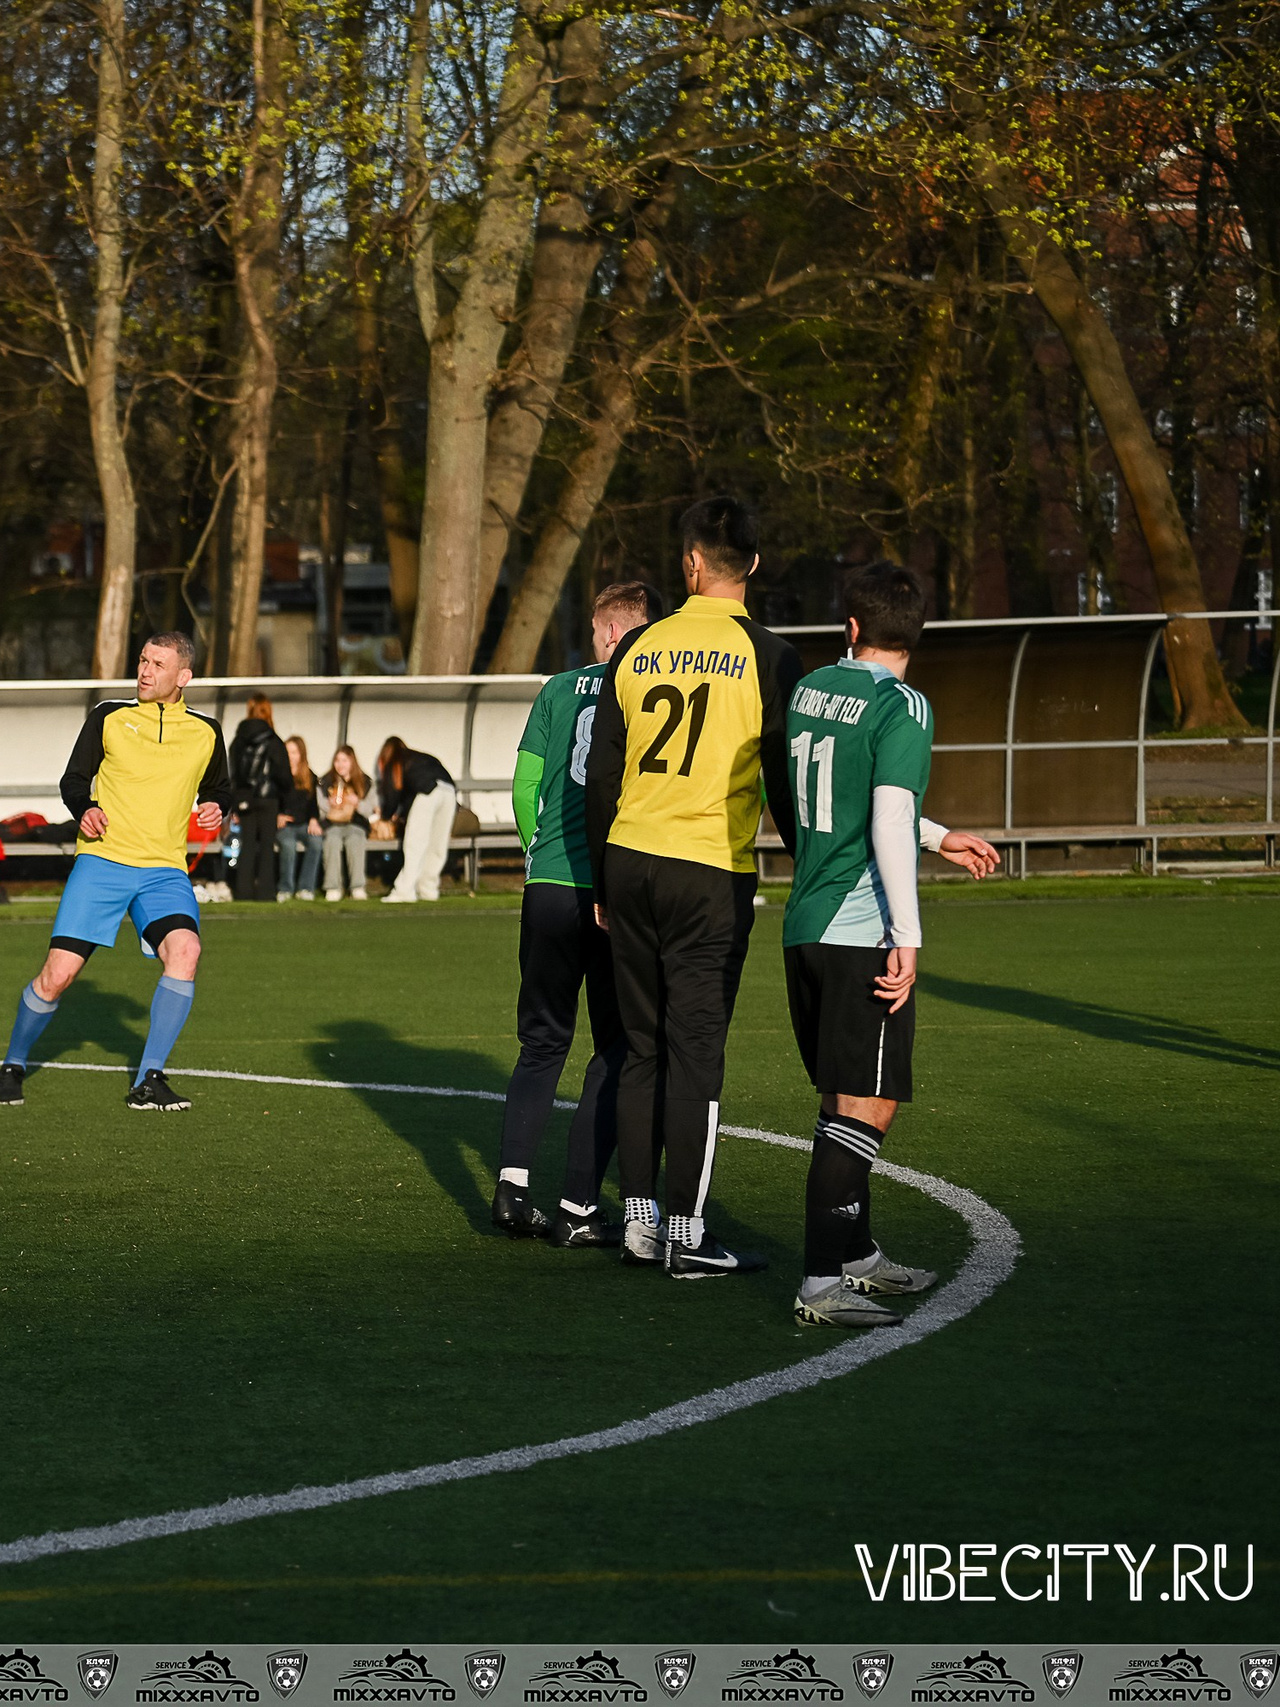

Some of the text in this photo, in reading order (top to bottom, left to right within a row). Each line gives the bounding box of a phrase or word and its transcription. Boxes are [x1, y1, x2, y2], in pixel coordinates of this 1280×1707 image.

[633, 649, 748, 680] ФК УРАЛАН
[575, 676, 590, 695] FC
[838, 696, 869, 726] FLEX
[638, 682, 711, 778] 21
[790, 731, 835, 834] 11
